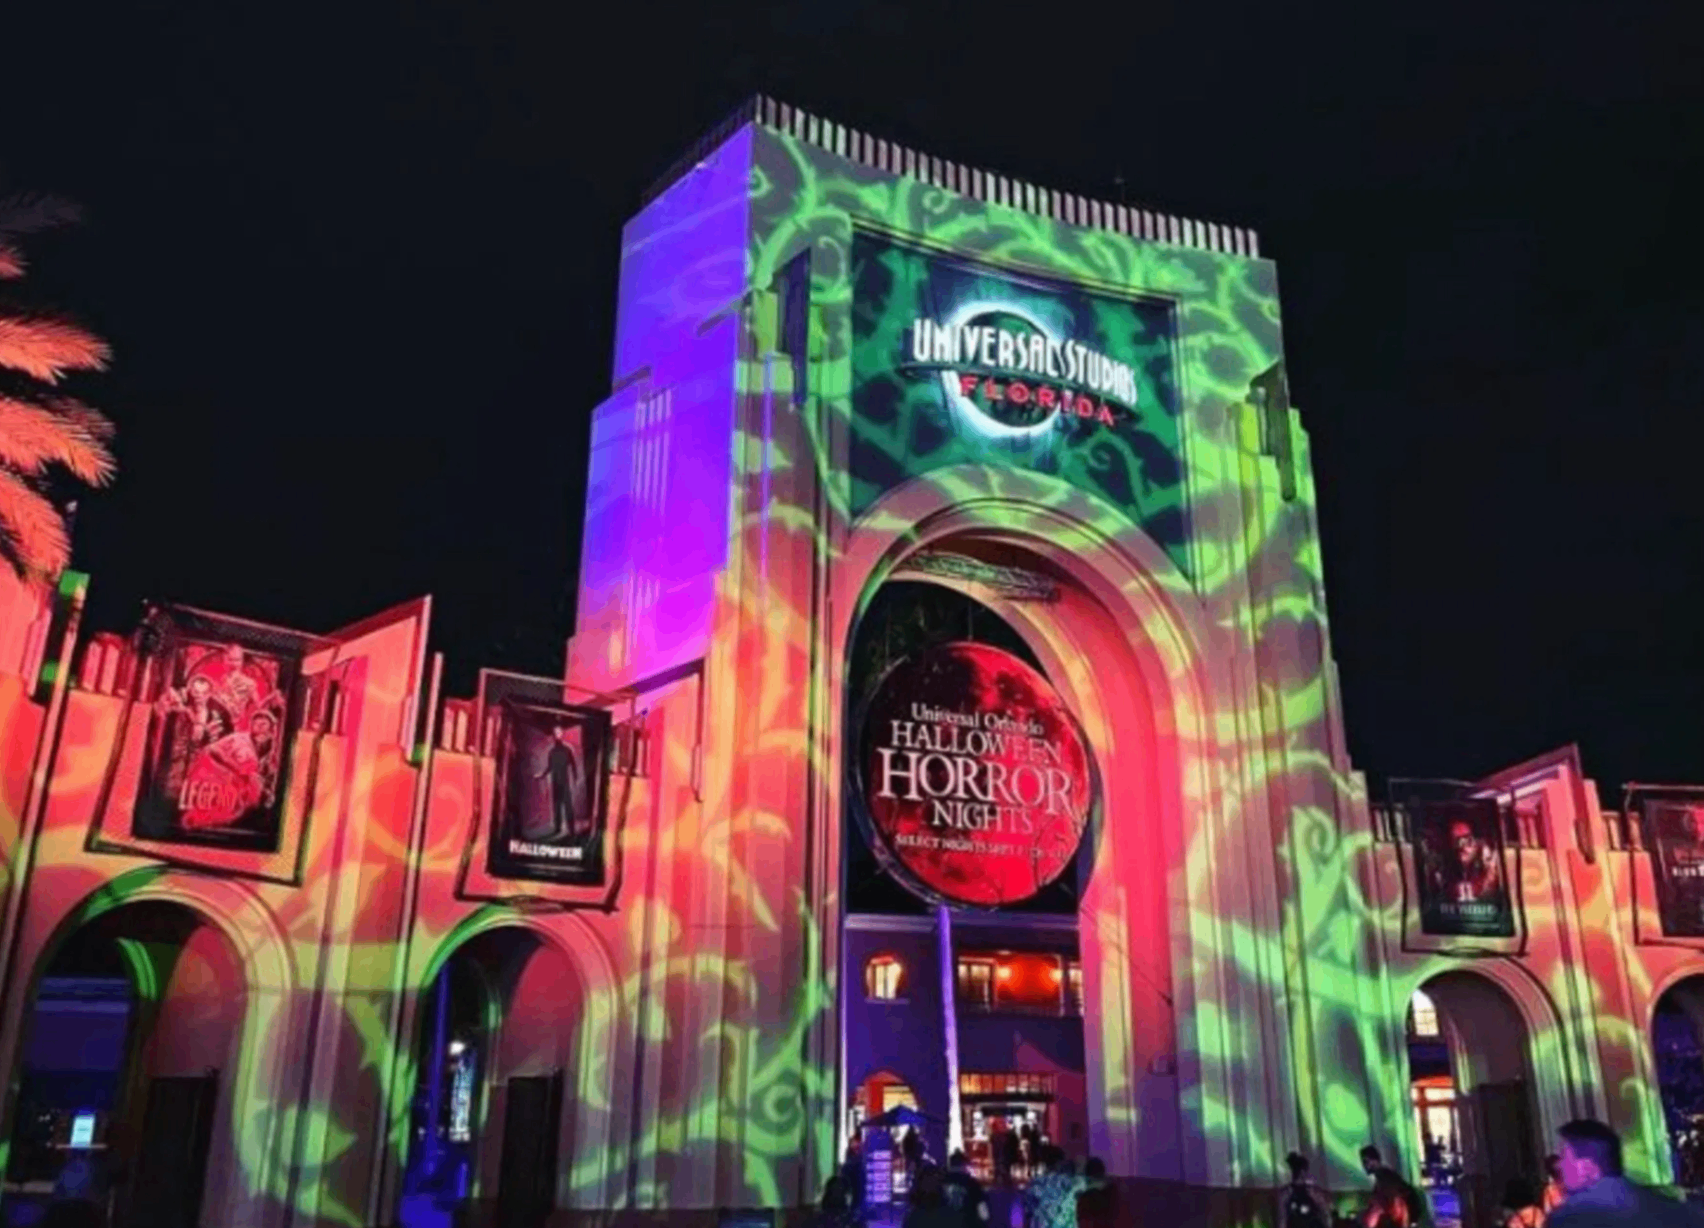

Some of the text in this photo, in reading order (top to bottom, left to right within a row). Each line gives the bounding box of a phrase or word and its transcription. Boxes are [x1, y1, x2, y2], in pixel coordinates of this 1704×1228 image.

[913, 318, 1137, 404] UNIVERSAL STUDIOS
[958, 374, 1116, 425] FLORIDA
[911, 702, 979, 727] Universal
[891, 720, 1061, 765] HALLOWEEN
[877, 747, 1079, 825] HORROR
[931, 800, 1034, 835] NIGHTS
[509, 838, 583, 861] HALLOWEEN
